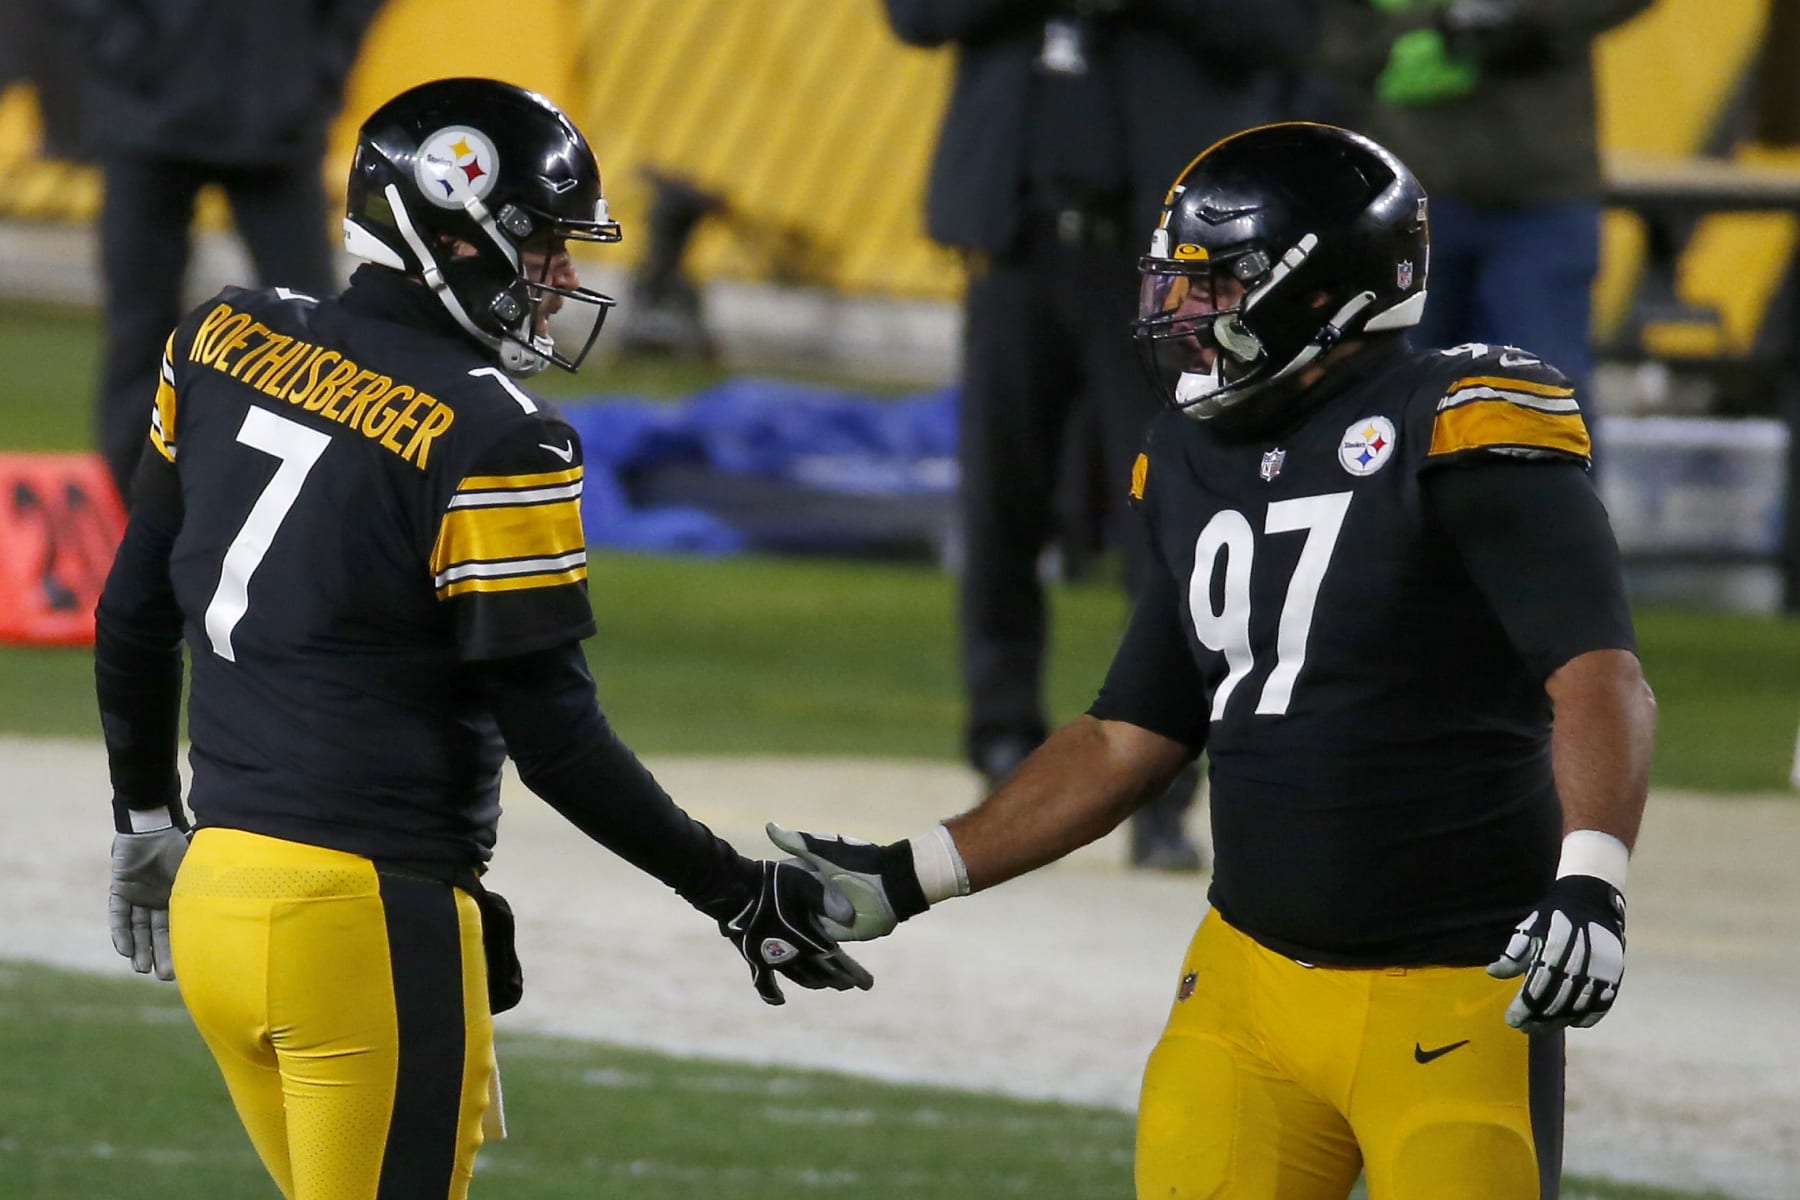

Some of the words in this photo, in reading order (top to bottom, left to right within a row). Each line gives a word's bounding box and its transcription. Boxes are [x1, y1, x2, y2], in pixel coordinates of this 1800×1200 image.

[189, 303, 455, 470] ROETHLISBERGER
[205, 405, 332, 662] 7
[1189, 491, 1353, 721] 97
